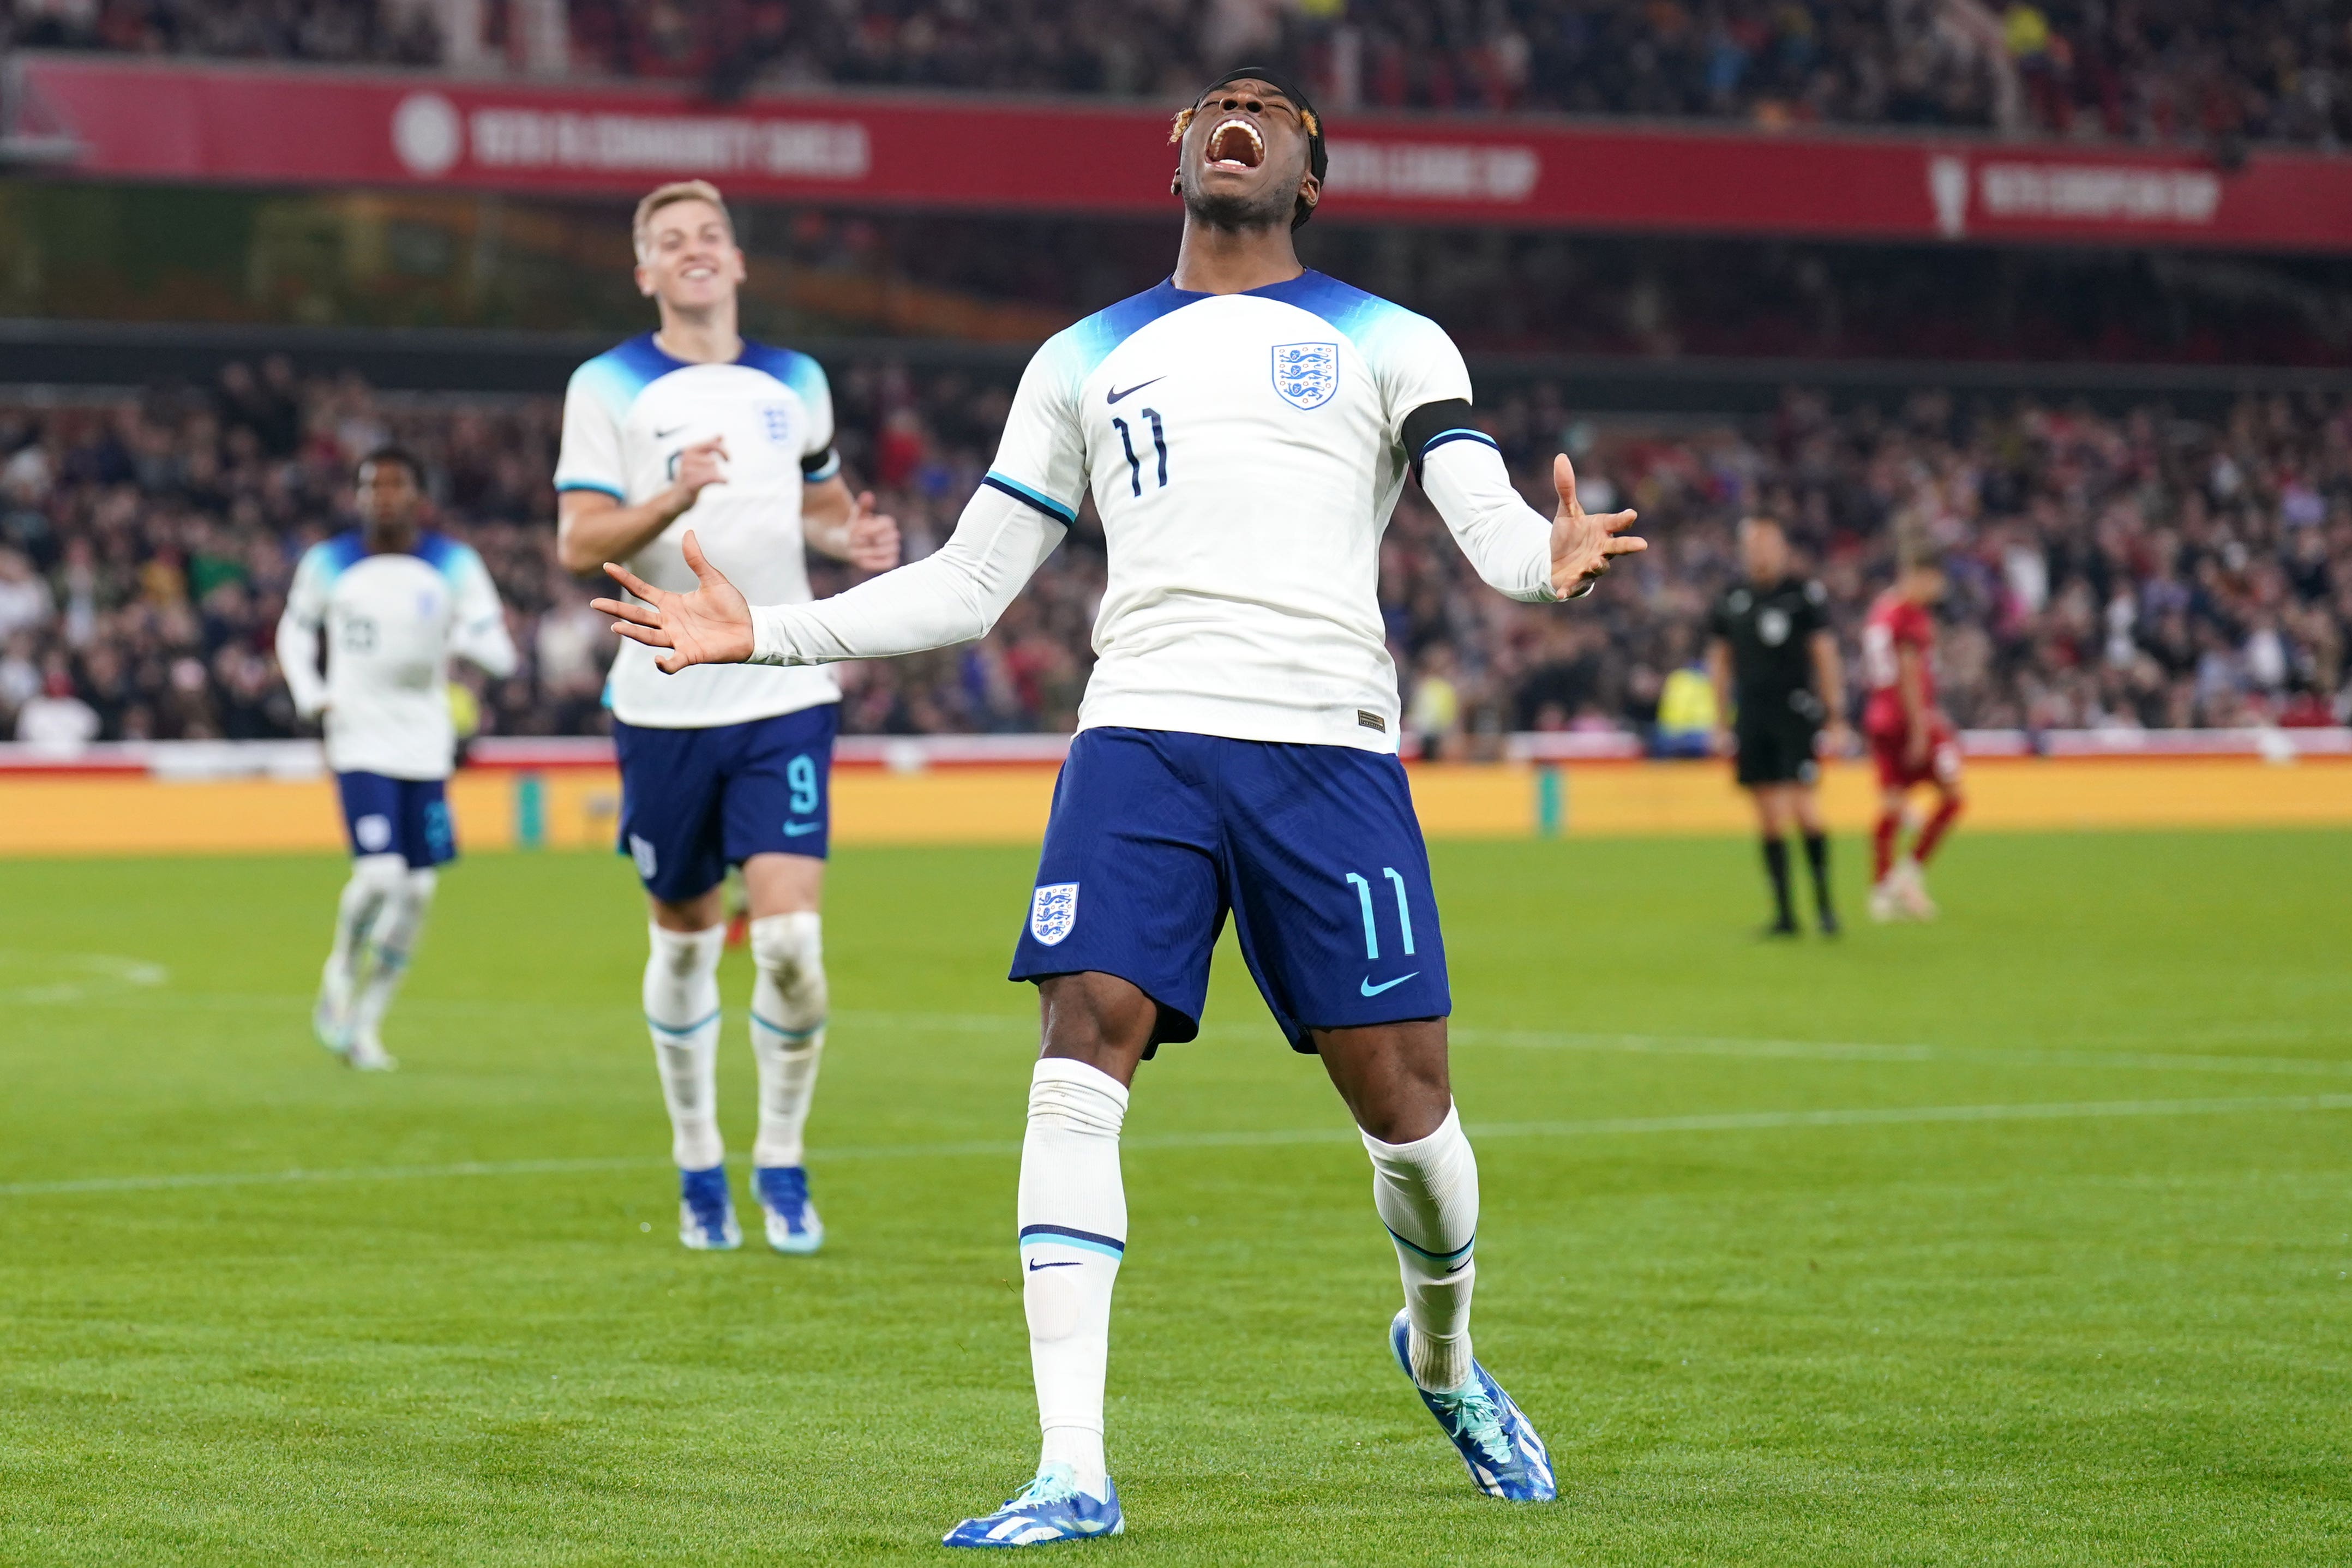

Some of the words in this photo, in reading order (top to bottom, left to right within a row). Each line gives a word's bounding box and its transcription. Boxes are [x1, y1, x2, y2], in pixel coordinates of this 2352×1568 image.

[1112, 407, 1167, 498] 11
[787, 753, 819, 814] 9
[1346, 867, 1415, 959] 11
